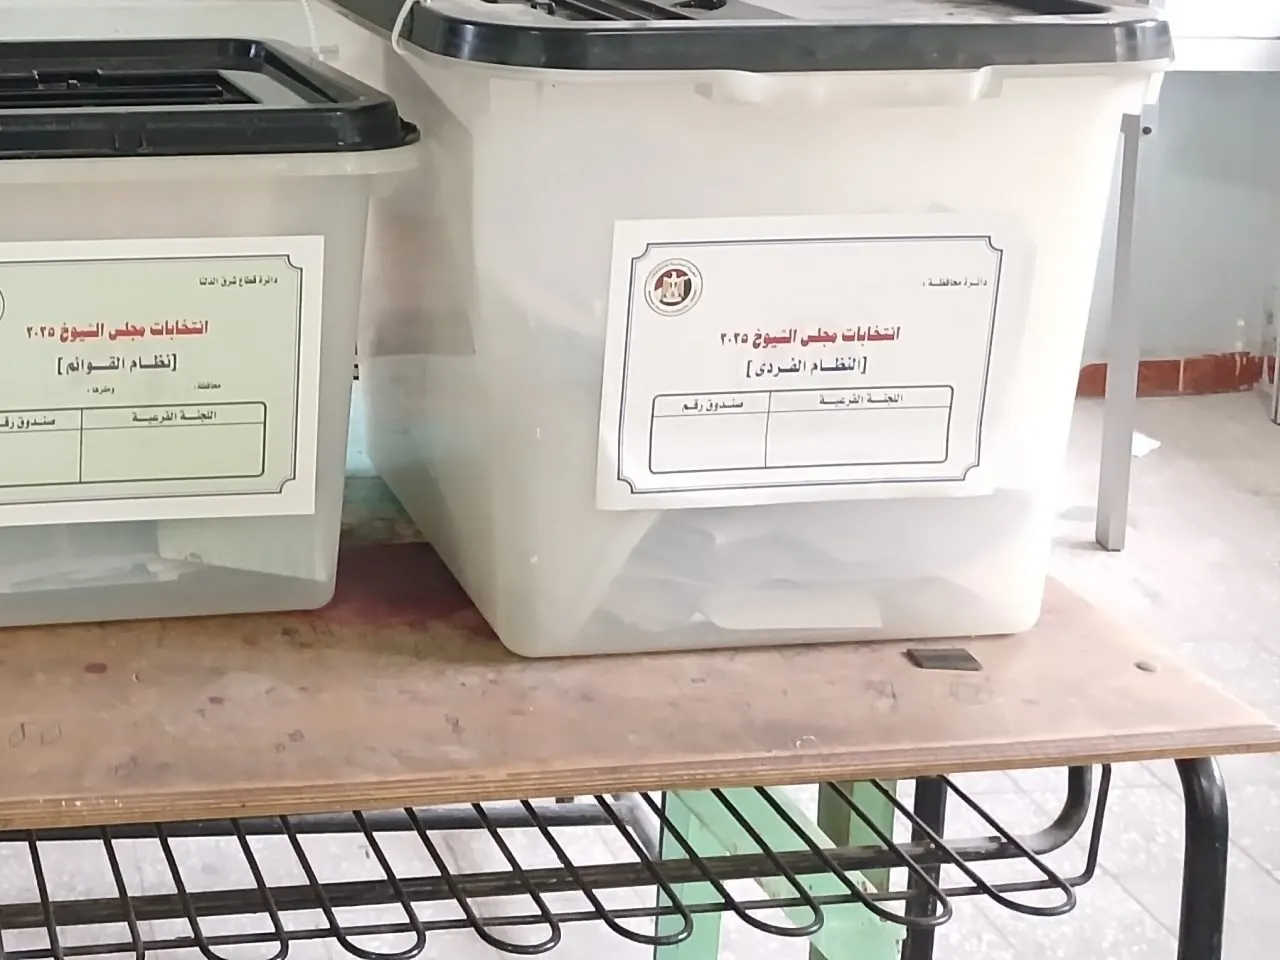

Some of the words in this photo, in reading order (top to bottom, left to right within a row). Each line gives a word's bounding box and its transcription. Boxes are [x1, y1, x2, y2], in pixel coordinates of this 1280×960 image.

[221, 273, 237, 287] شرق
[26, 326, 56, 340] ٢٠٢٥
[59, 321, 105, 343] الشيوخ
[108, 321, 146, 342] مجلس
[149, 319, 209, 341] انتخابات
[800, 327, 838, 348] مجلس
[841, 324, 901, 347] انتخابات
[720, 332, 749, 346] ٢٠٢٥
[752, 328, 798, 349] الشيوخ
[681, 398, 704, 413] رقم
[705, 397, 744, 412] صندوق
[819, 394, 864, 407] الفرعية
[866, 393, 904, 406] اللجنة
[16, 415, 56, 430] صندوق
[132, 410, 177, 423] الفرعية
[180, 410, 217, 423] اللجنة
